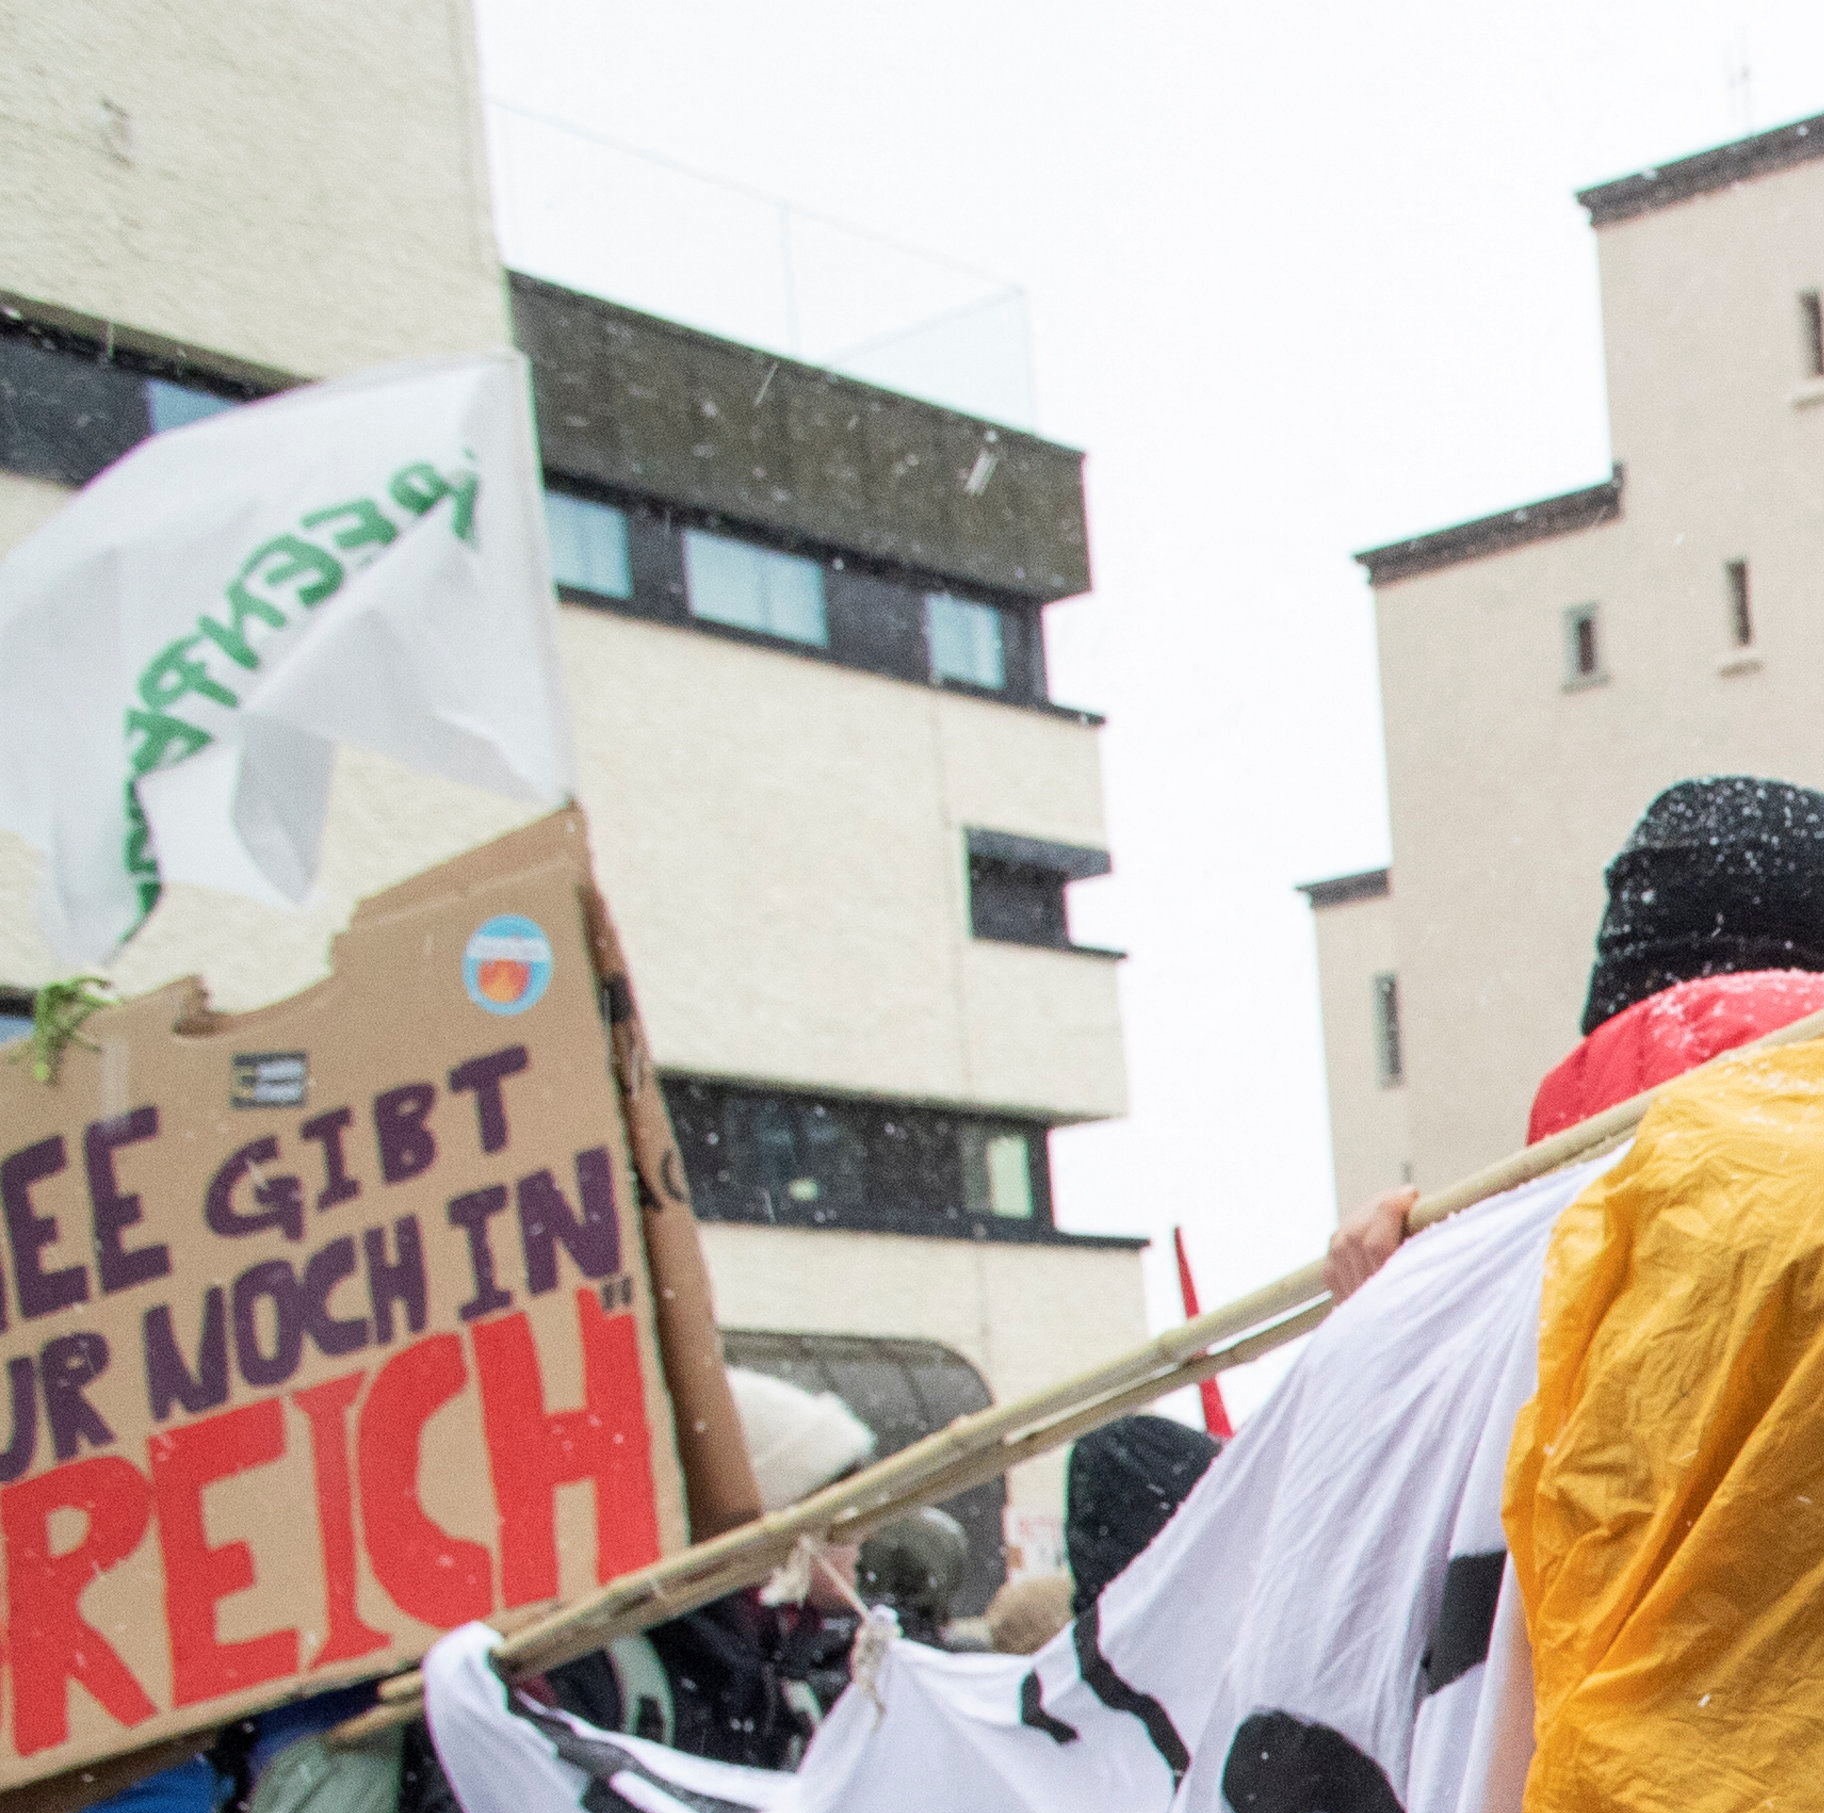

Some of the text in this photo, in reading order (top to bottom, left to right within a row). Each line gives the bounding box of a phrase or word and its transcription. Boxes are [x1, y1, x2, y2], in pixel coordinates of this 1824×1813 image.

[0, 1045, 530, 1334] EE GIBT
[143, 1216, 428, 1422] NOCH
[447, 1146, 621, 1322] IN
